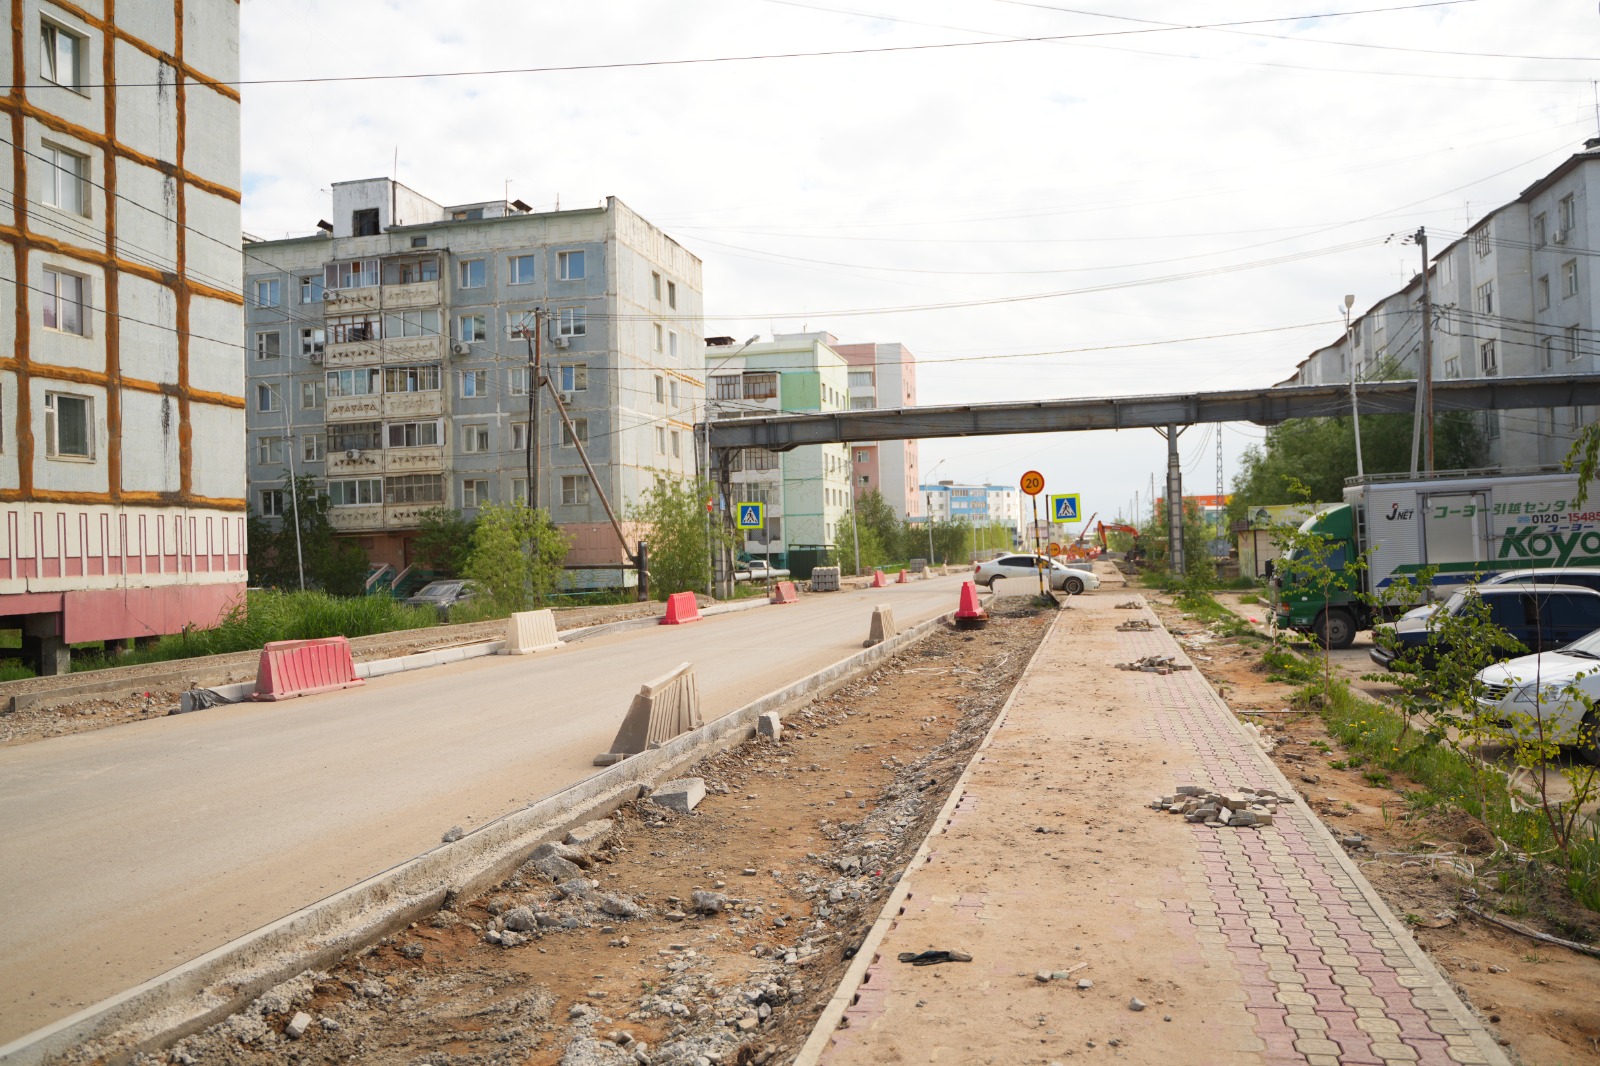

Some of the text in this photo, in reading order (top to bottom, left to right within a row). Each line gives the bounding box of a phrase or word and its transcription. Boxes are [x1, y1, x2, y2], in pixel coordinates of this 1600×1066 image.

[1025, 477, 1039, 489] 20
[1546, 523, 1594, 533] コーヨー
